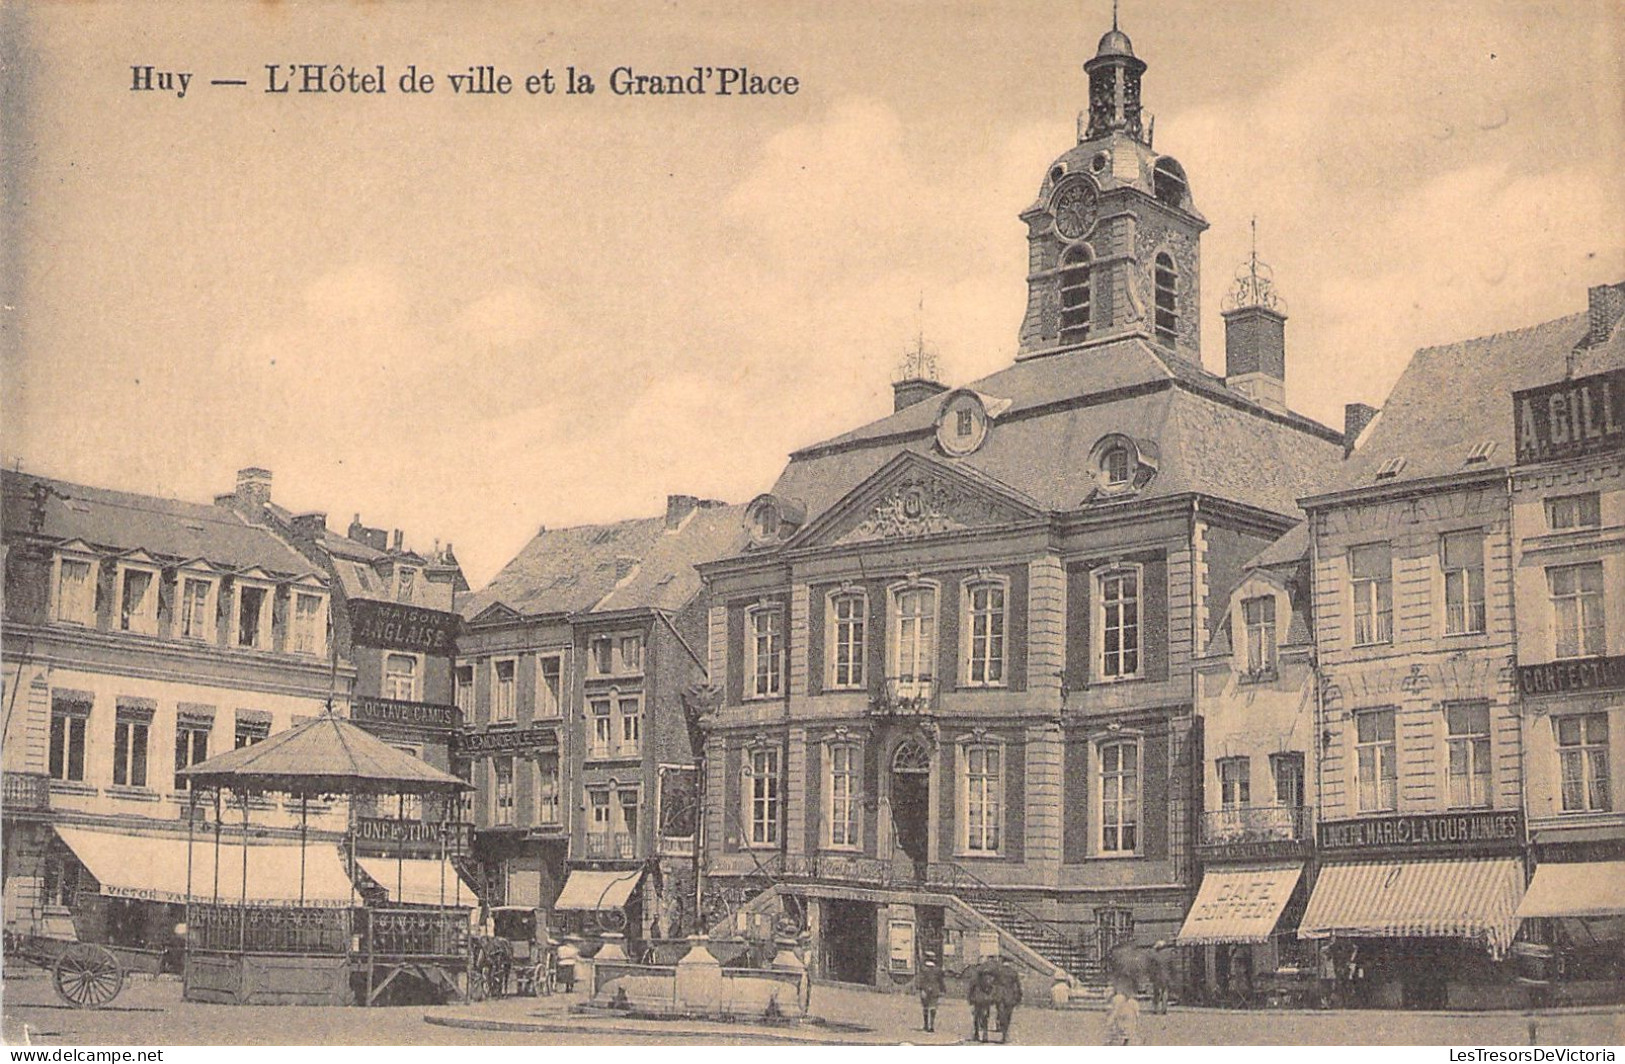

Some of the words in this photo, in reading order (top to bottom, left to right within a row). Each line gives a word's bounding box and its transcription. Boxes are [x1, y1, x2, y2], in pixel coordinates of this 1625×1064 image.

[379, 606, 440, 624] MAISON
[361, 621, 445, 648] ANGLAISE
[364, 701, 409, 720] OCTAVE
[414, 706, 452, 724] CAMUS
[1411, 817, 1467, 842] LATOUR
[107, 886, 157, 900] VICTOR
